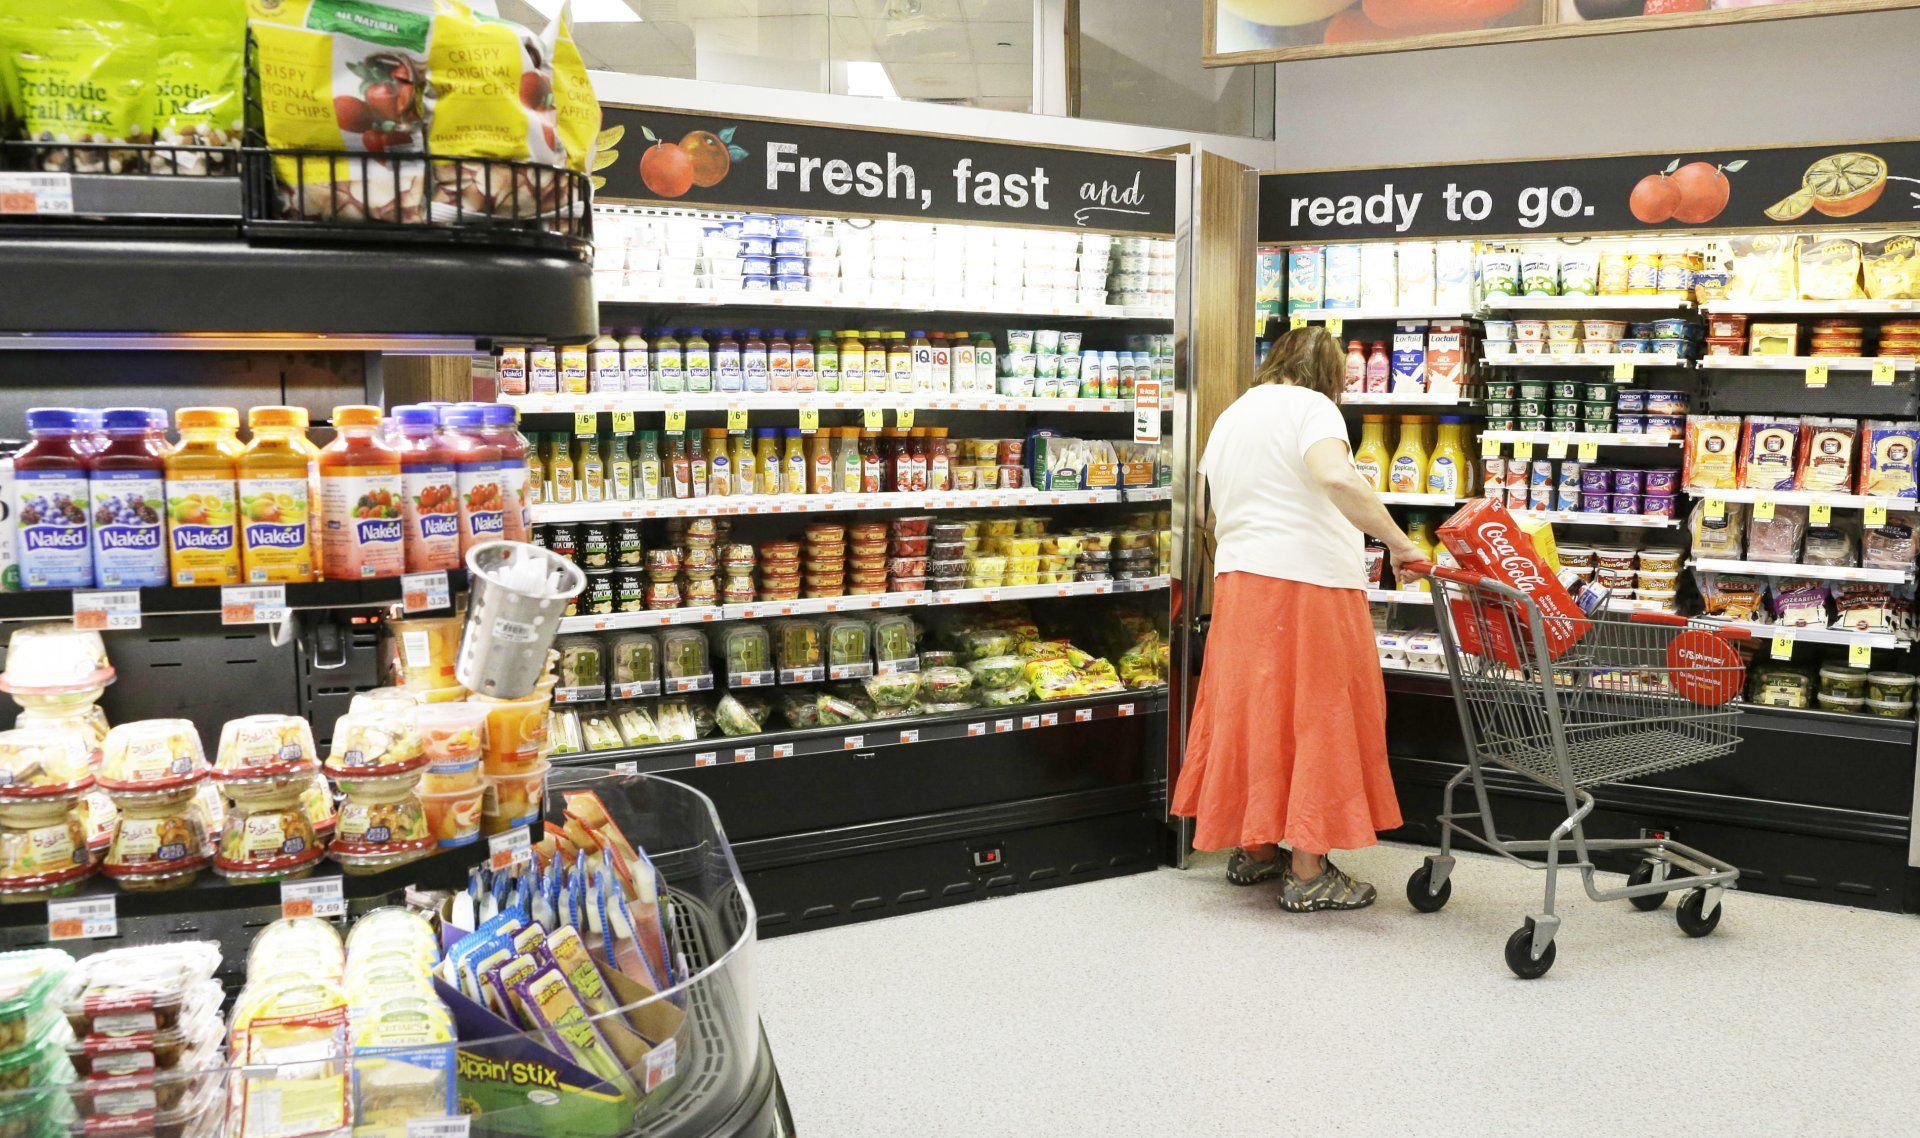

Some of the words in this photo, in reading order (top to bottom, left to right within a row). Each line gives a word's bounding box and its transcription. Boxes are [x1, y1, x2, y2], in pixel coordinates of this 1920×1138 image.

[354, 14, 400, 34] NATURAL
[448, 48, 500, 63] CRISPY
[264, 64, 306, 82] RISPY
[446, 66, 511, 79] ORIGINAL
[18, 77, 107, 102] Probiotic
[65, 102, 113, 125] Mix
[285, 101, 331, 118] CHIPS
[766, 141, 932, 210] Fresh,
[953, 158, 1049, 210] fast
[1079, 171, 1145, 207] and
[1290, 183, 1423, 232] ready
[1442, 183, 1492, 221] to
[1517, 185, 1595, 229] go.
[1394, 334, 1421, 342] Lactaid
[1430, 334, 1458, 342] Lactaid
[915, 350, 930, 363] iQ
[932, 351, 948, 365] iQ
[958, 350, 973, 364] iQ
[976, 351, 993, 365] iQ
[362, 523, 401, 540] Naked
[425, 518, 458, 535] Naked
[475, 516, 503, 532] Naked
[29, 529, 84, 548] Naked
[103, 529, 157, 547] Naked
[177, 529, 229, 546] Naked
[250, 528, 302, 546] Naked
[1477, 521, 1548, 594] Coca-Cola
[512, 1062, 558, 1088] Stix
